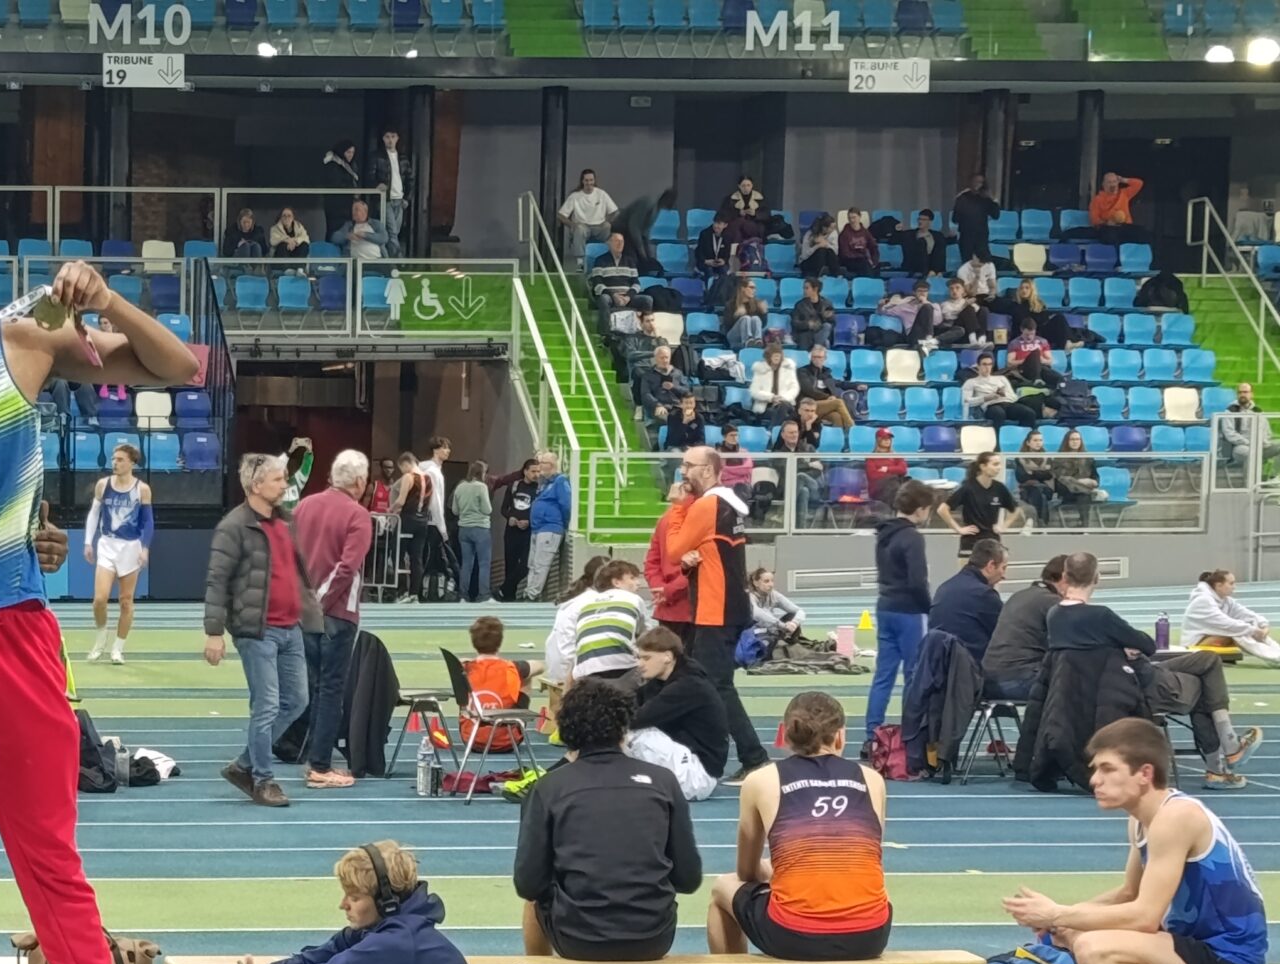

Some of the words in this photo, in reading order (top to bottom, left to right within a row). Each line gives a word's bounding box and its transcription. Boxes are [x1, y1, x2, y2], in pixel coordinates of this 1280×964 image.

[88, 3, 192, 46] M10
[745, 10, 845, 51] M11
[107, 55, 153, 65] TRIBUNE
[105, 69, 127, 85] 19
[854, 75, 876, 90] 20
[811, 795, 849, 818] 59
